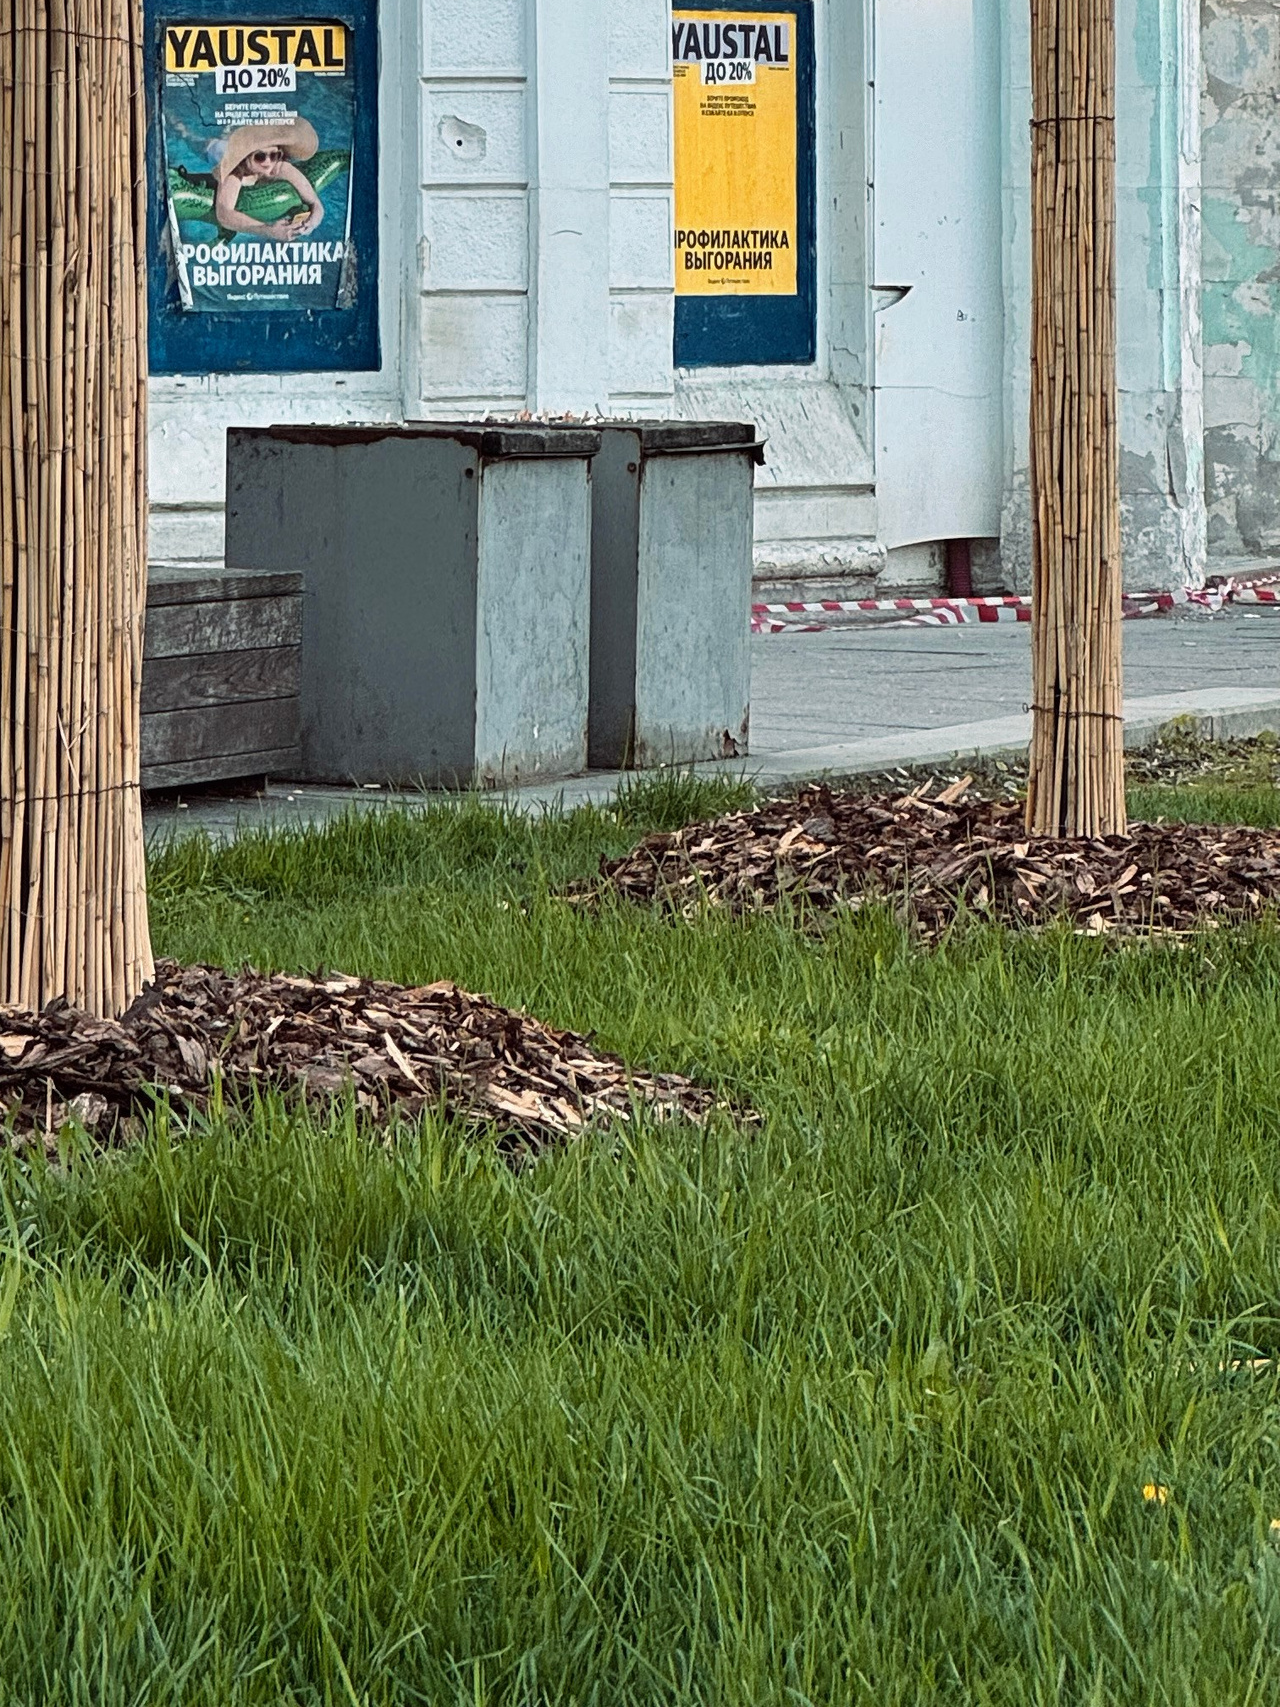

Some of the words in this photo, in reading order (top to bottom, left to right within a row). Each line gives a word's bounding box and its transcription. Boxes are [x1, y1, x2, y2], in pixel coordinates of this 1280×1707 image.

[167, 28, 344, 68] YAUSTAL
[222, 69, 252, 92] ДО
[257, 67, 290, 88] 20%
[705, 62, 726, 84] ДО
[729, 61, 752, 81] 20%
[182, 241, 344, 264] РОФИЛАКТИКА
[685, 251, 772, 270] ВЫГОРАНИЯ
[193, 264, 322, 286] ВЫГОРАНИЯ
